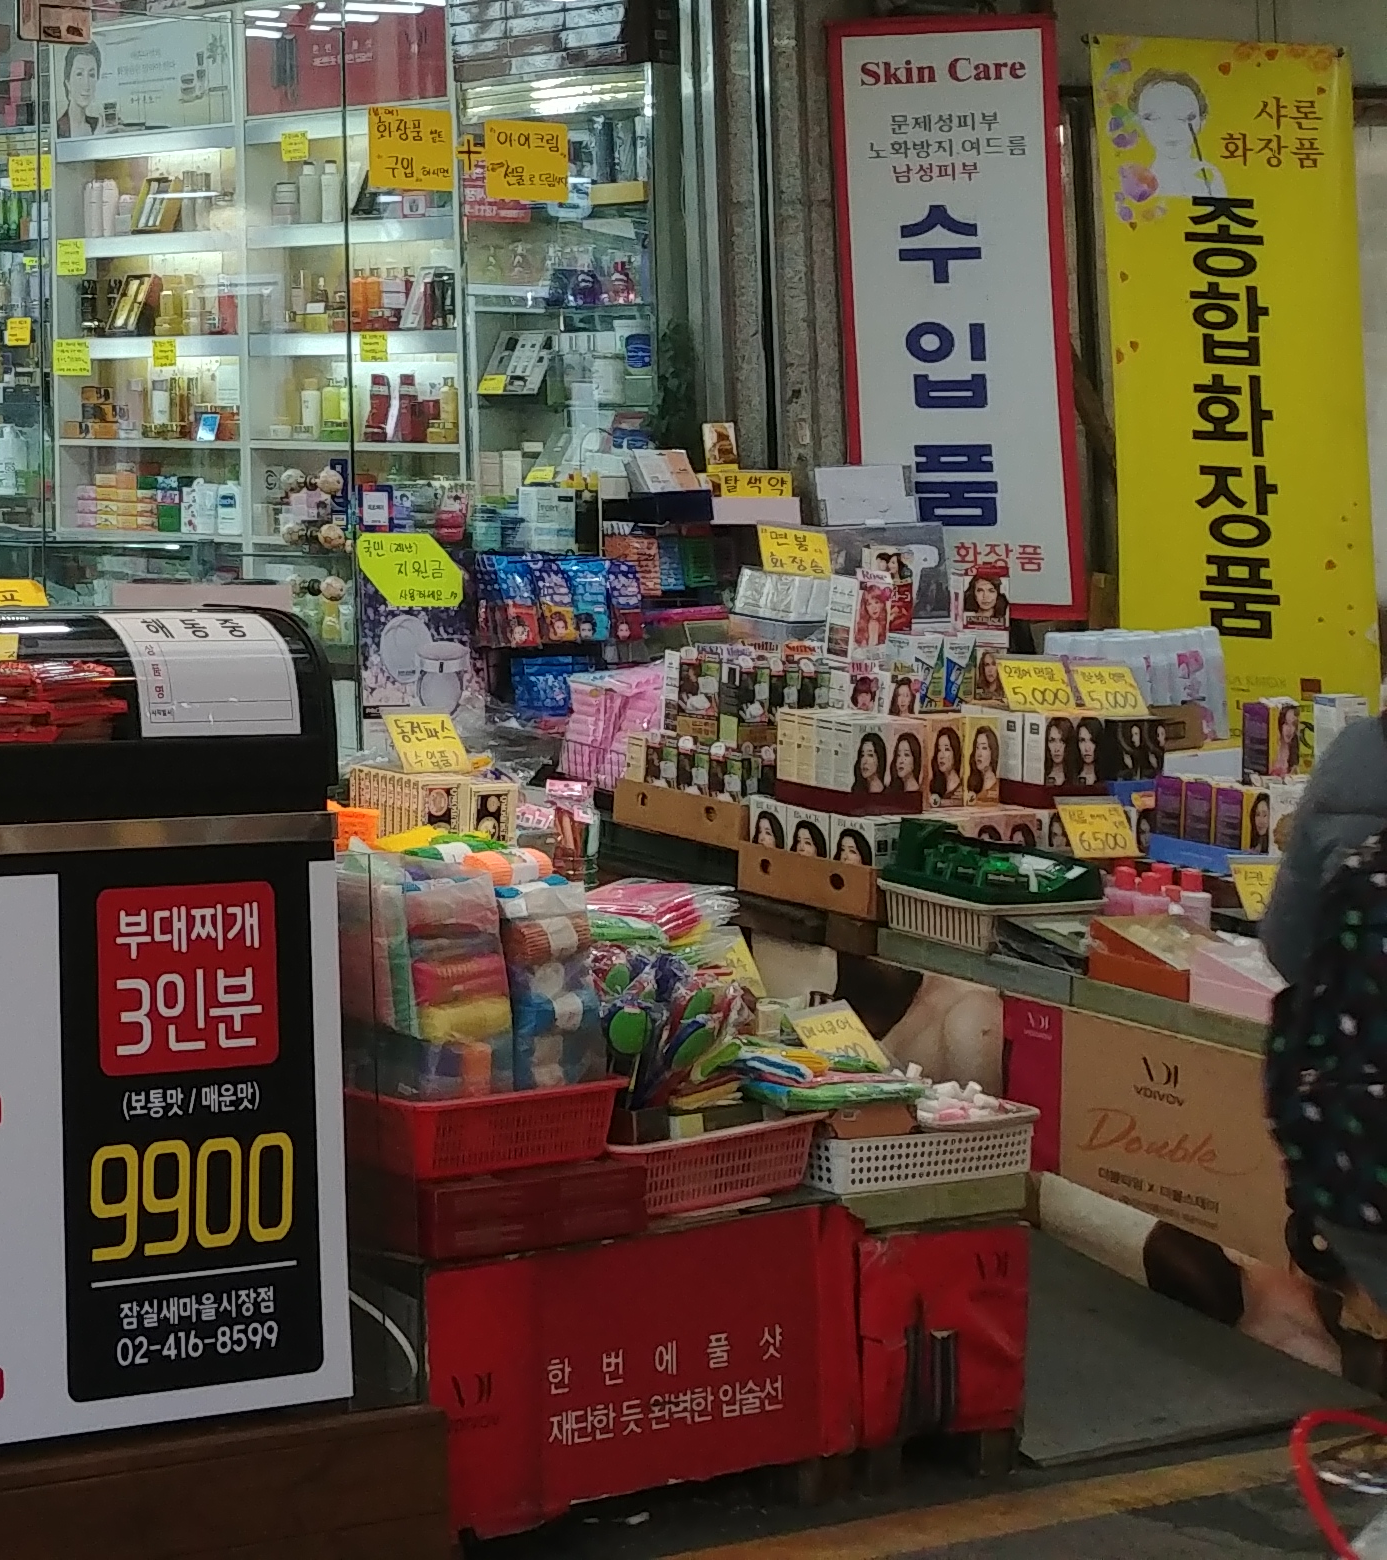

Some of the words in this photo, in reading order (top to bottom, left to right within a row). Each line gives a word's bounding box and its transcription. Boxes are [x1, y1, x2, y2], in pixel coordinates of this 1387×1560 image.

[859, 58, 936, 89] Skin
[946, 56, 1027, 84] Care
[888, 111, 1001, 134] 문제성피부
[1253, 96, 1325, 132] 샤론
[384, 155, 415, 179] 구입
[891, 161, 980, 184] 남성피부
[1219, 132, 1325, 171] 화장품
[898, 203, 998, 528] 수입품
[1184, 195, 1282, 640] 종합화장품
[394, 559, 446, 581] 지원금
[951, 540, 1045, 574] 화장품
[114, 900, 262, 960] 부대찌개
[114, 966, 264, 1057] 3인분
[1077, 1107, 1232, 1170] Double
[89, 1130, 294, 1263] 9900
[118, 1285, 276, 1330] 잠실새마을시장점
[115, 1319, 280, 1368] 02-416-8599
[548, 1402, 617, 1447] 재단한
[620, 1399, 643, 1437] 듯
[647, 1385, 716, 1431] 완벽한
[719, 1374, 784, 1419] 입술선
